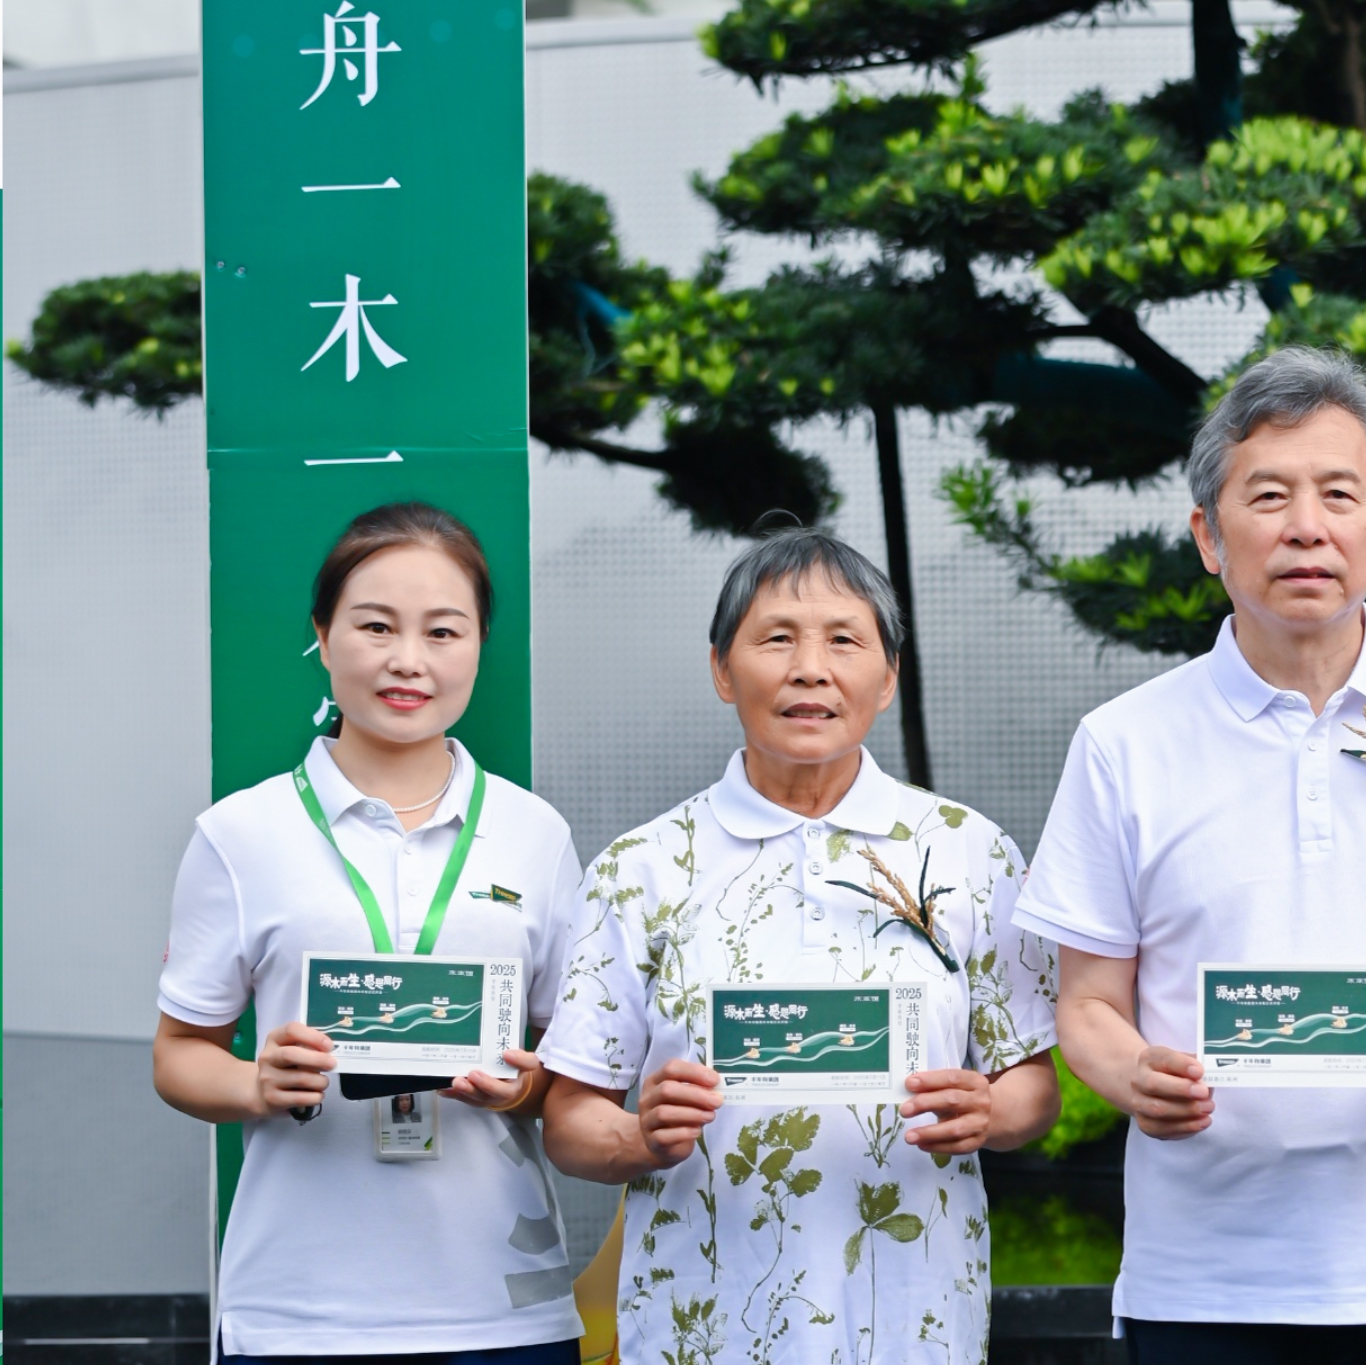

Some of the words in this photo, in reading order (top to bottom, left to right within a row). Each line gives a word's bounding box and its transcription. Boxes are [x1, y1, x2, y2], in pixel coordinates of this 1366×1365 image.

[490, 964, 516, 976] 2025
[895, 988, 922, 1000] 2025
[905, 1003, 920, 1075] 共同驶向未
